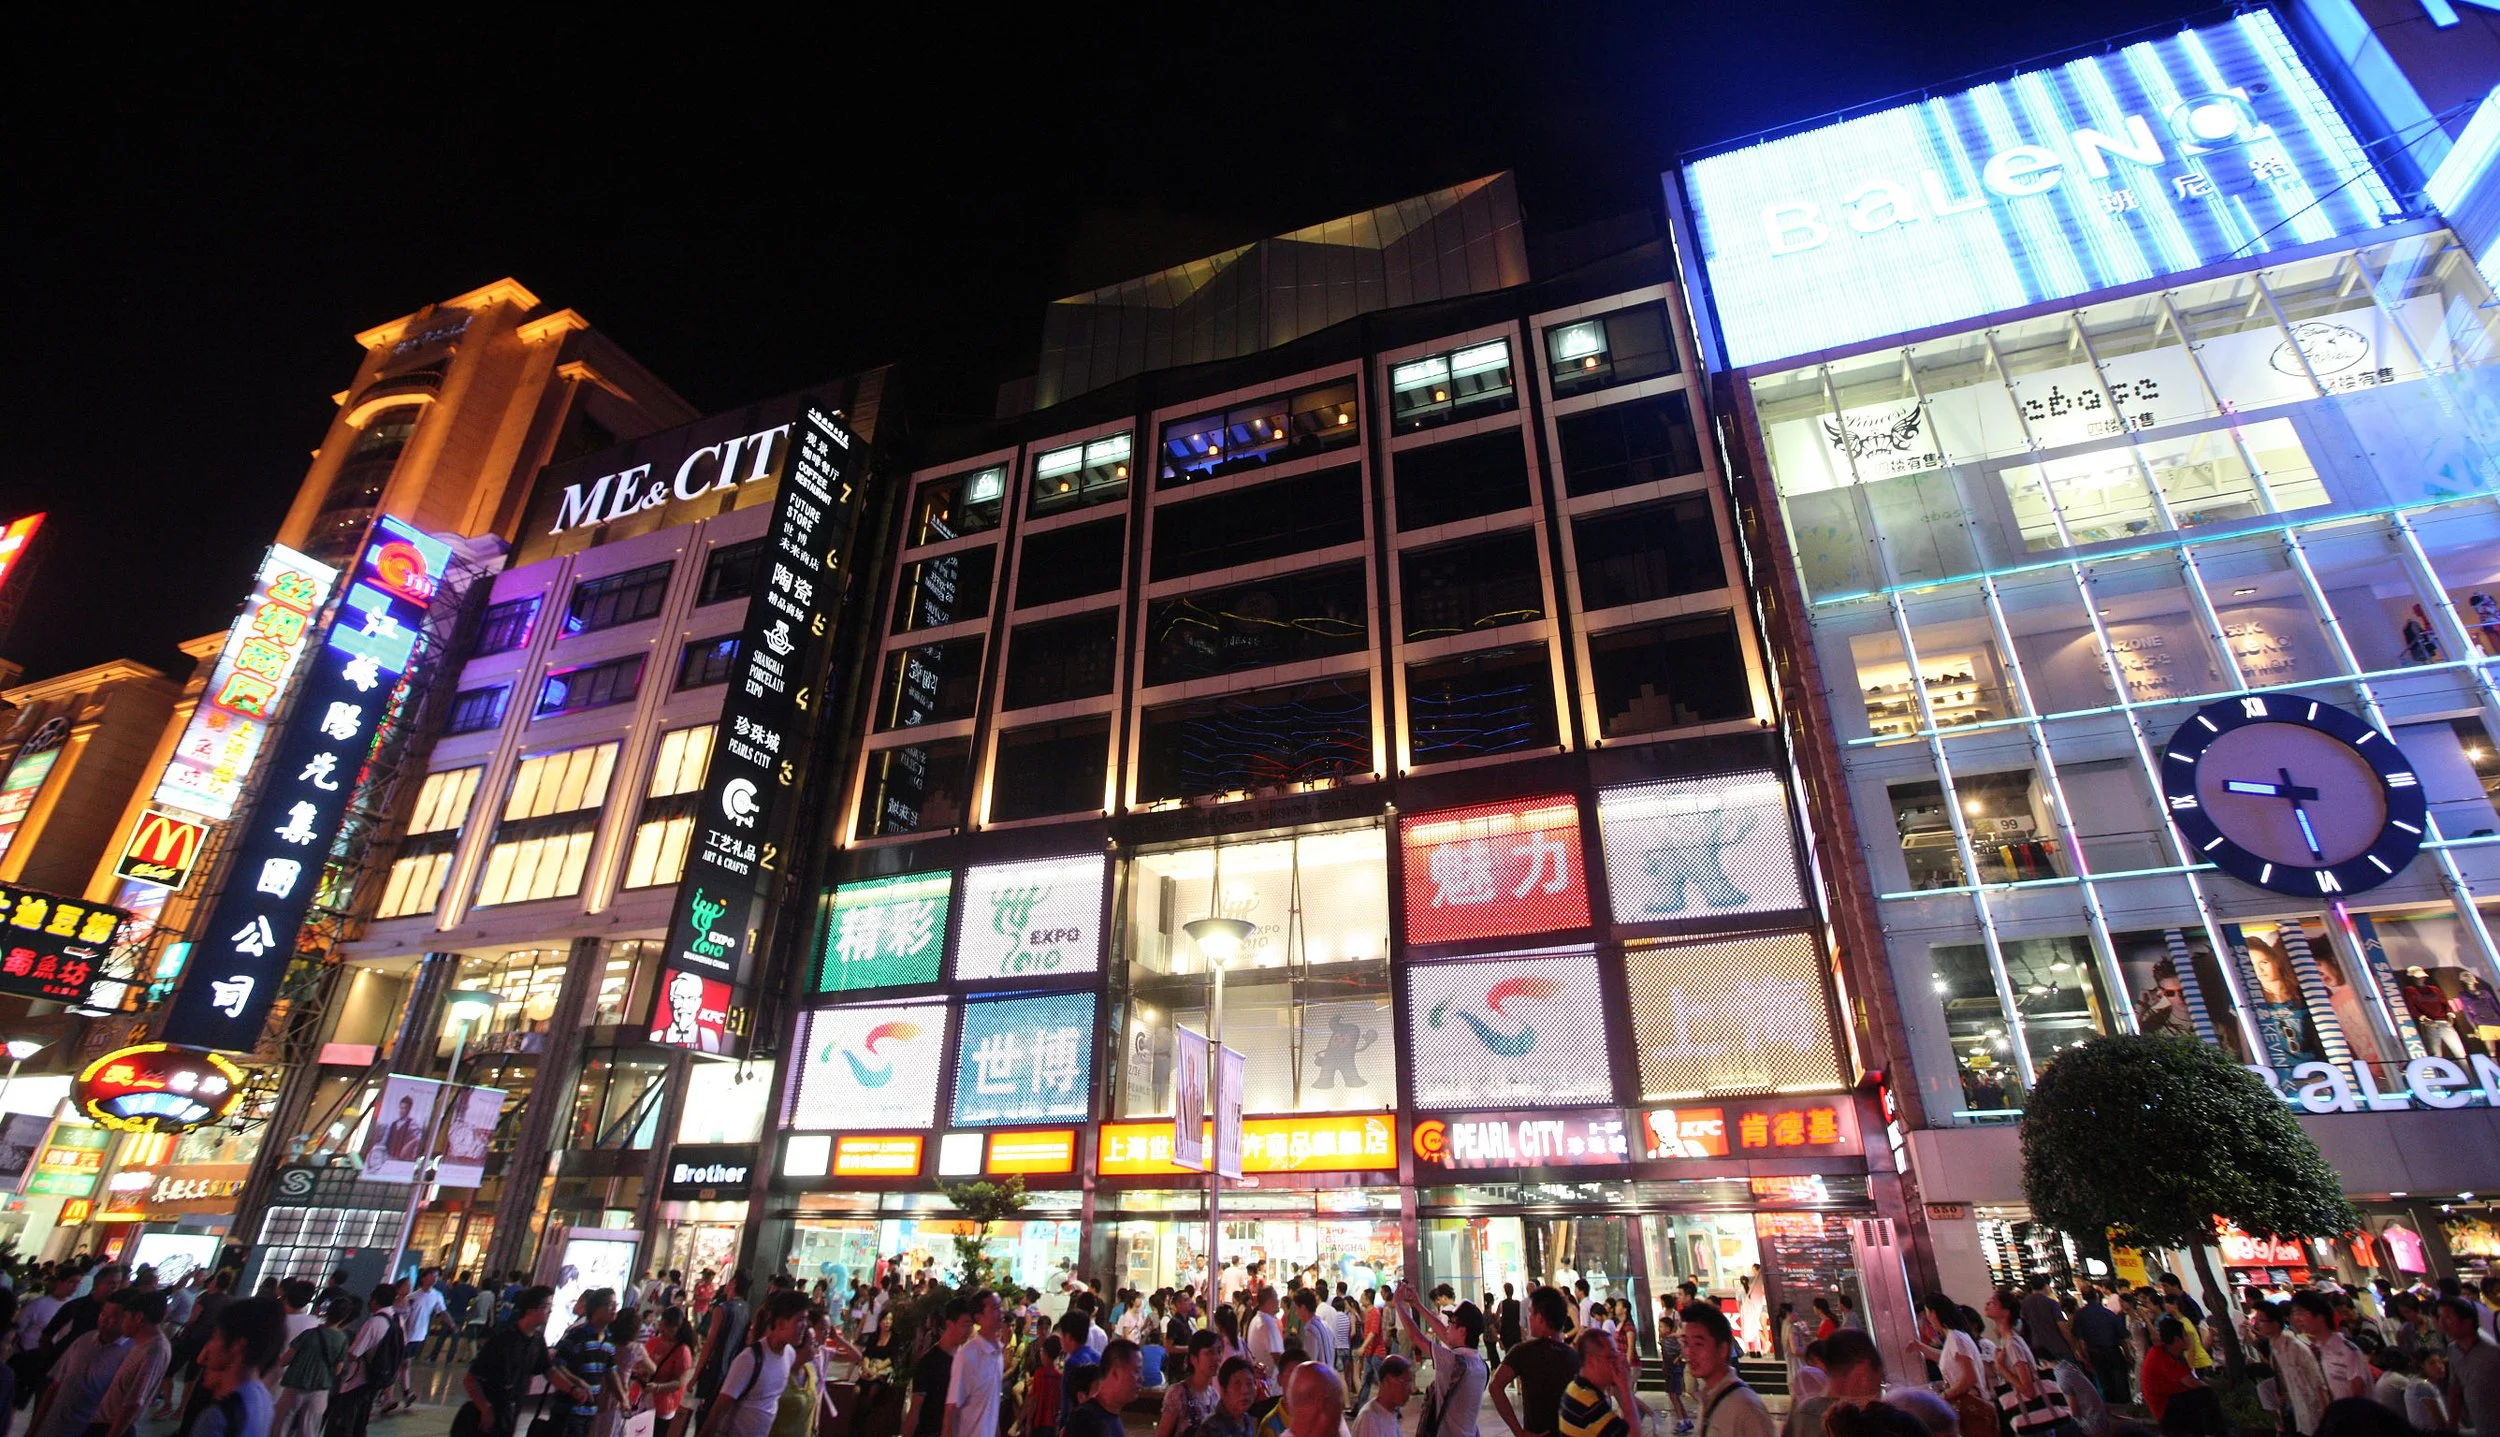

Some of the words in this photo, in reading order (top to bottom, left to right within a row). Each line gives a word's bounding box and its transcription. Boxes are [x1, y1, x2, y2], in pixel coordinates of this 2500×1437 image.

[2100, 154, 2292, 216] 班尼路
[798, 460, 828, 491] COFFEE
[801, 445, 840, 482] 咖啡餐厅
[794, 471, 833, 506] RESTAURANT
[786, 505, 814, 533] STORE
[789, 492, 822, 524] FUTURE
[783, 521, 808, 547] 世博
[779, 536, 820, 572] 未来商店
[771, 561, 814, 607] 陶瓷
[767, 590, 805, 623] 精品商场
[749, 663, 786, 694] PORCELAIN
[752, 649, 785, 678] SHANGHAI
[745, 678, 763, 699] EXPO
[733, 715, 782, 754] 珍珠城
[728, 737, 754, 762] PEARLS
[753, 749, 772, 770] CITY
[2000, 818, 2018, 830] 99
[705, 828, 757, 863] 工艺礼品
[760, 842, 777, 871] 2
[702, 849, 718, 864] ART
[723, 855, 749, 876] CRAFTS
[1428, 829, 1570, 908] 魅力
[708, 931, 736, 948] EXPO
[835, 898, 936, 963] 精彩
[1030, 926, 1081, 947] EXPO
[1256, 923, 1281, 936] XPO
[682, 950, 713, 967] SHANGHAI
[2234, 943, 2263, 1005] SAMUEL
[2260, 1022, 2289, 1068] KEVIN
[2374, 961, 2407, 1024] SAMUEL
[697, 1008, 727, 1025] KFC
[972, 1026, 1083, 1096] 世博
[1452, 1121, 1516, 1160] PEARL
[1518, 1120, 1565, 1158] CITY
[1679, 1118, 1724, 1138] KFC
[1739, 1107, 1838, 1149] 肯德基
[1103, 1130, 1389, 1163] 上海世会许商品旗舰店
[673, 1162, 748, 1187] Brother
